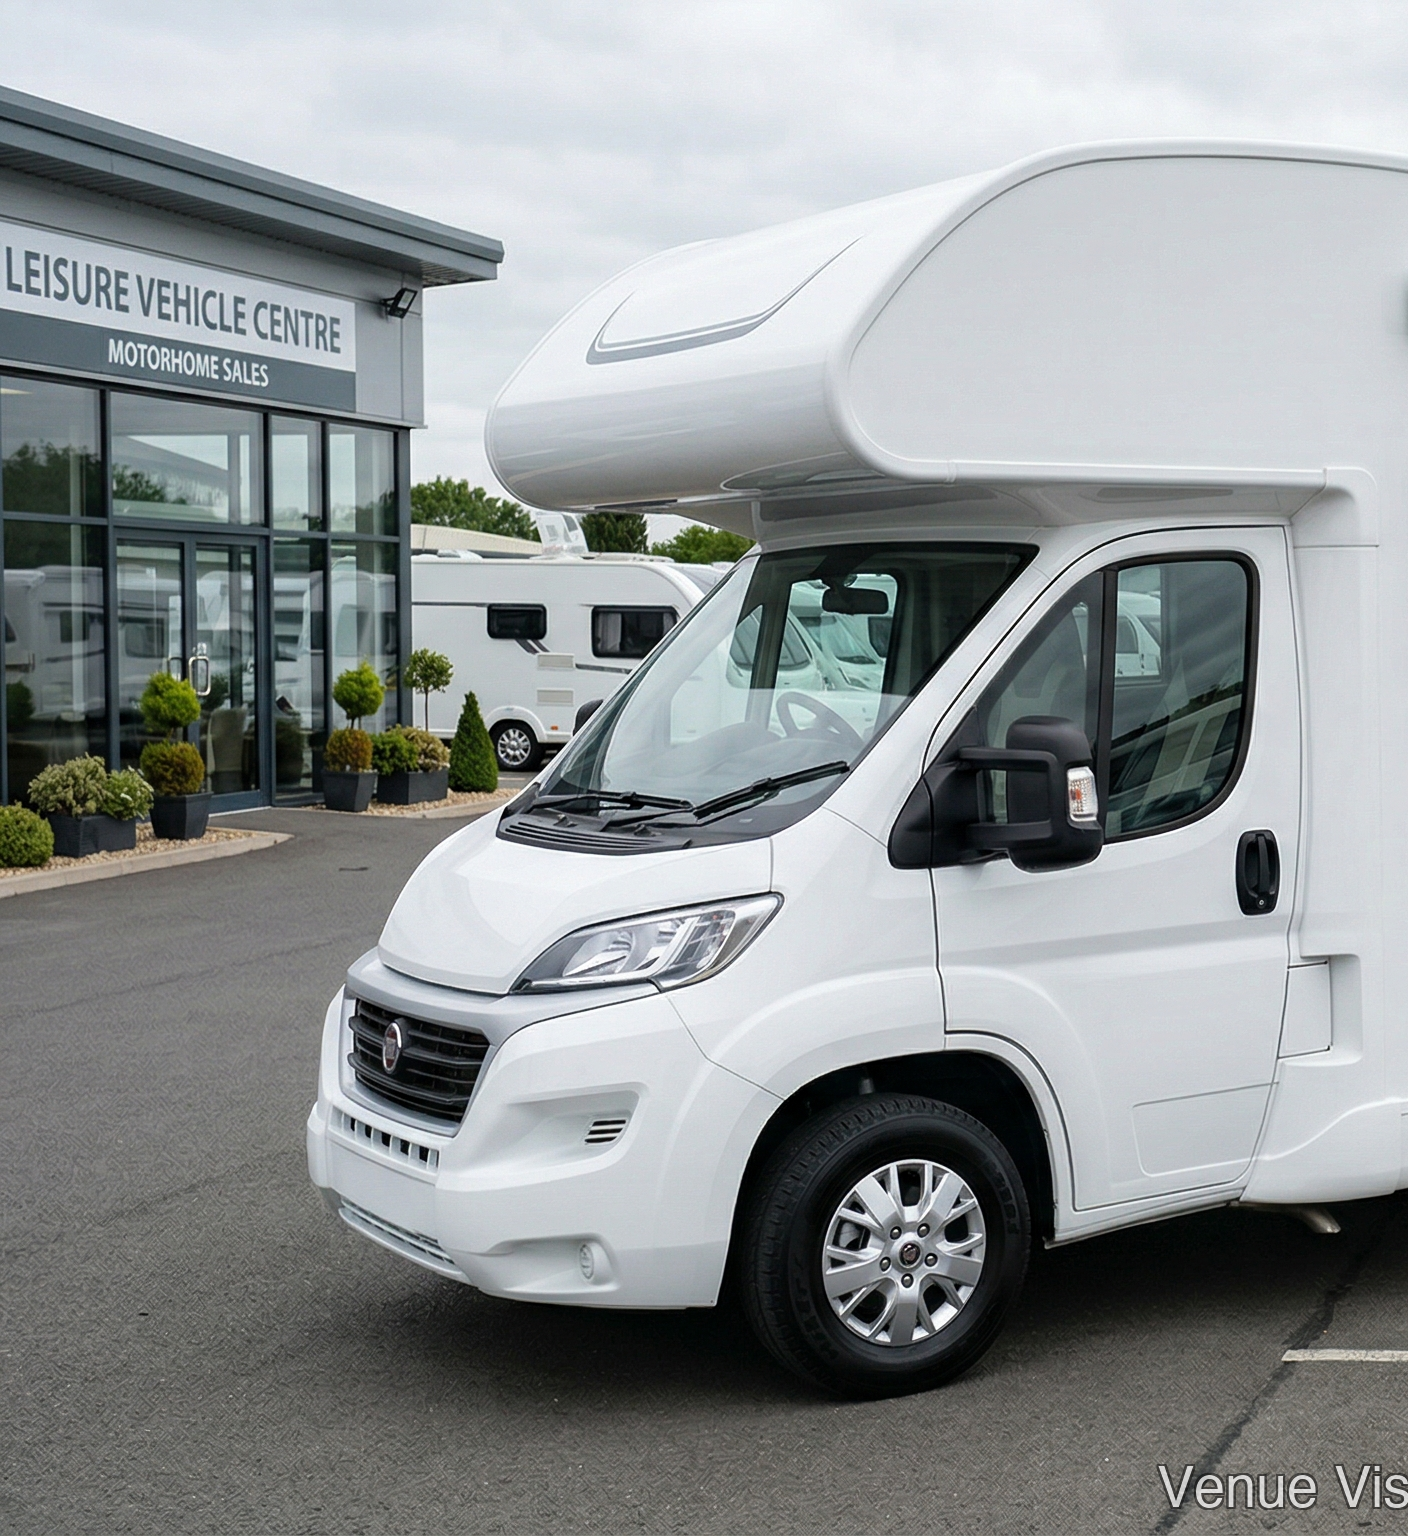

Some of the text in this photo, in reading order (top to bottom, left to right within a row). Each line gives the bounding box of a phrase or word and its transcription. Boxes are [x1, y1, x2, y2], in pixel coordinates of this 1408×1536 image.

[5, 245, 341, 354] LEISURE VEHICLE CENTRE
[108, 338, 269, 388] MOTORHOME SALES
